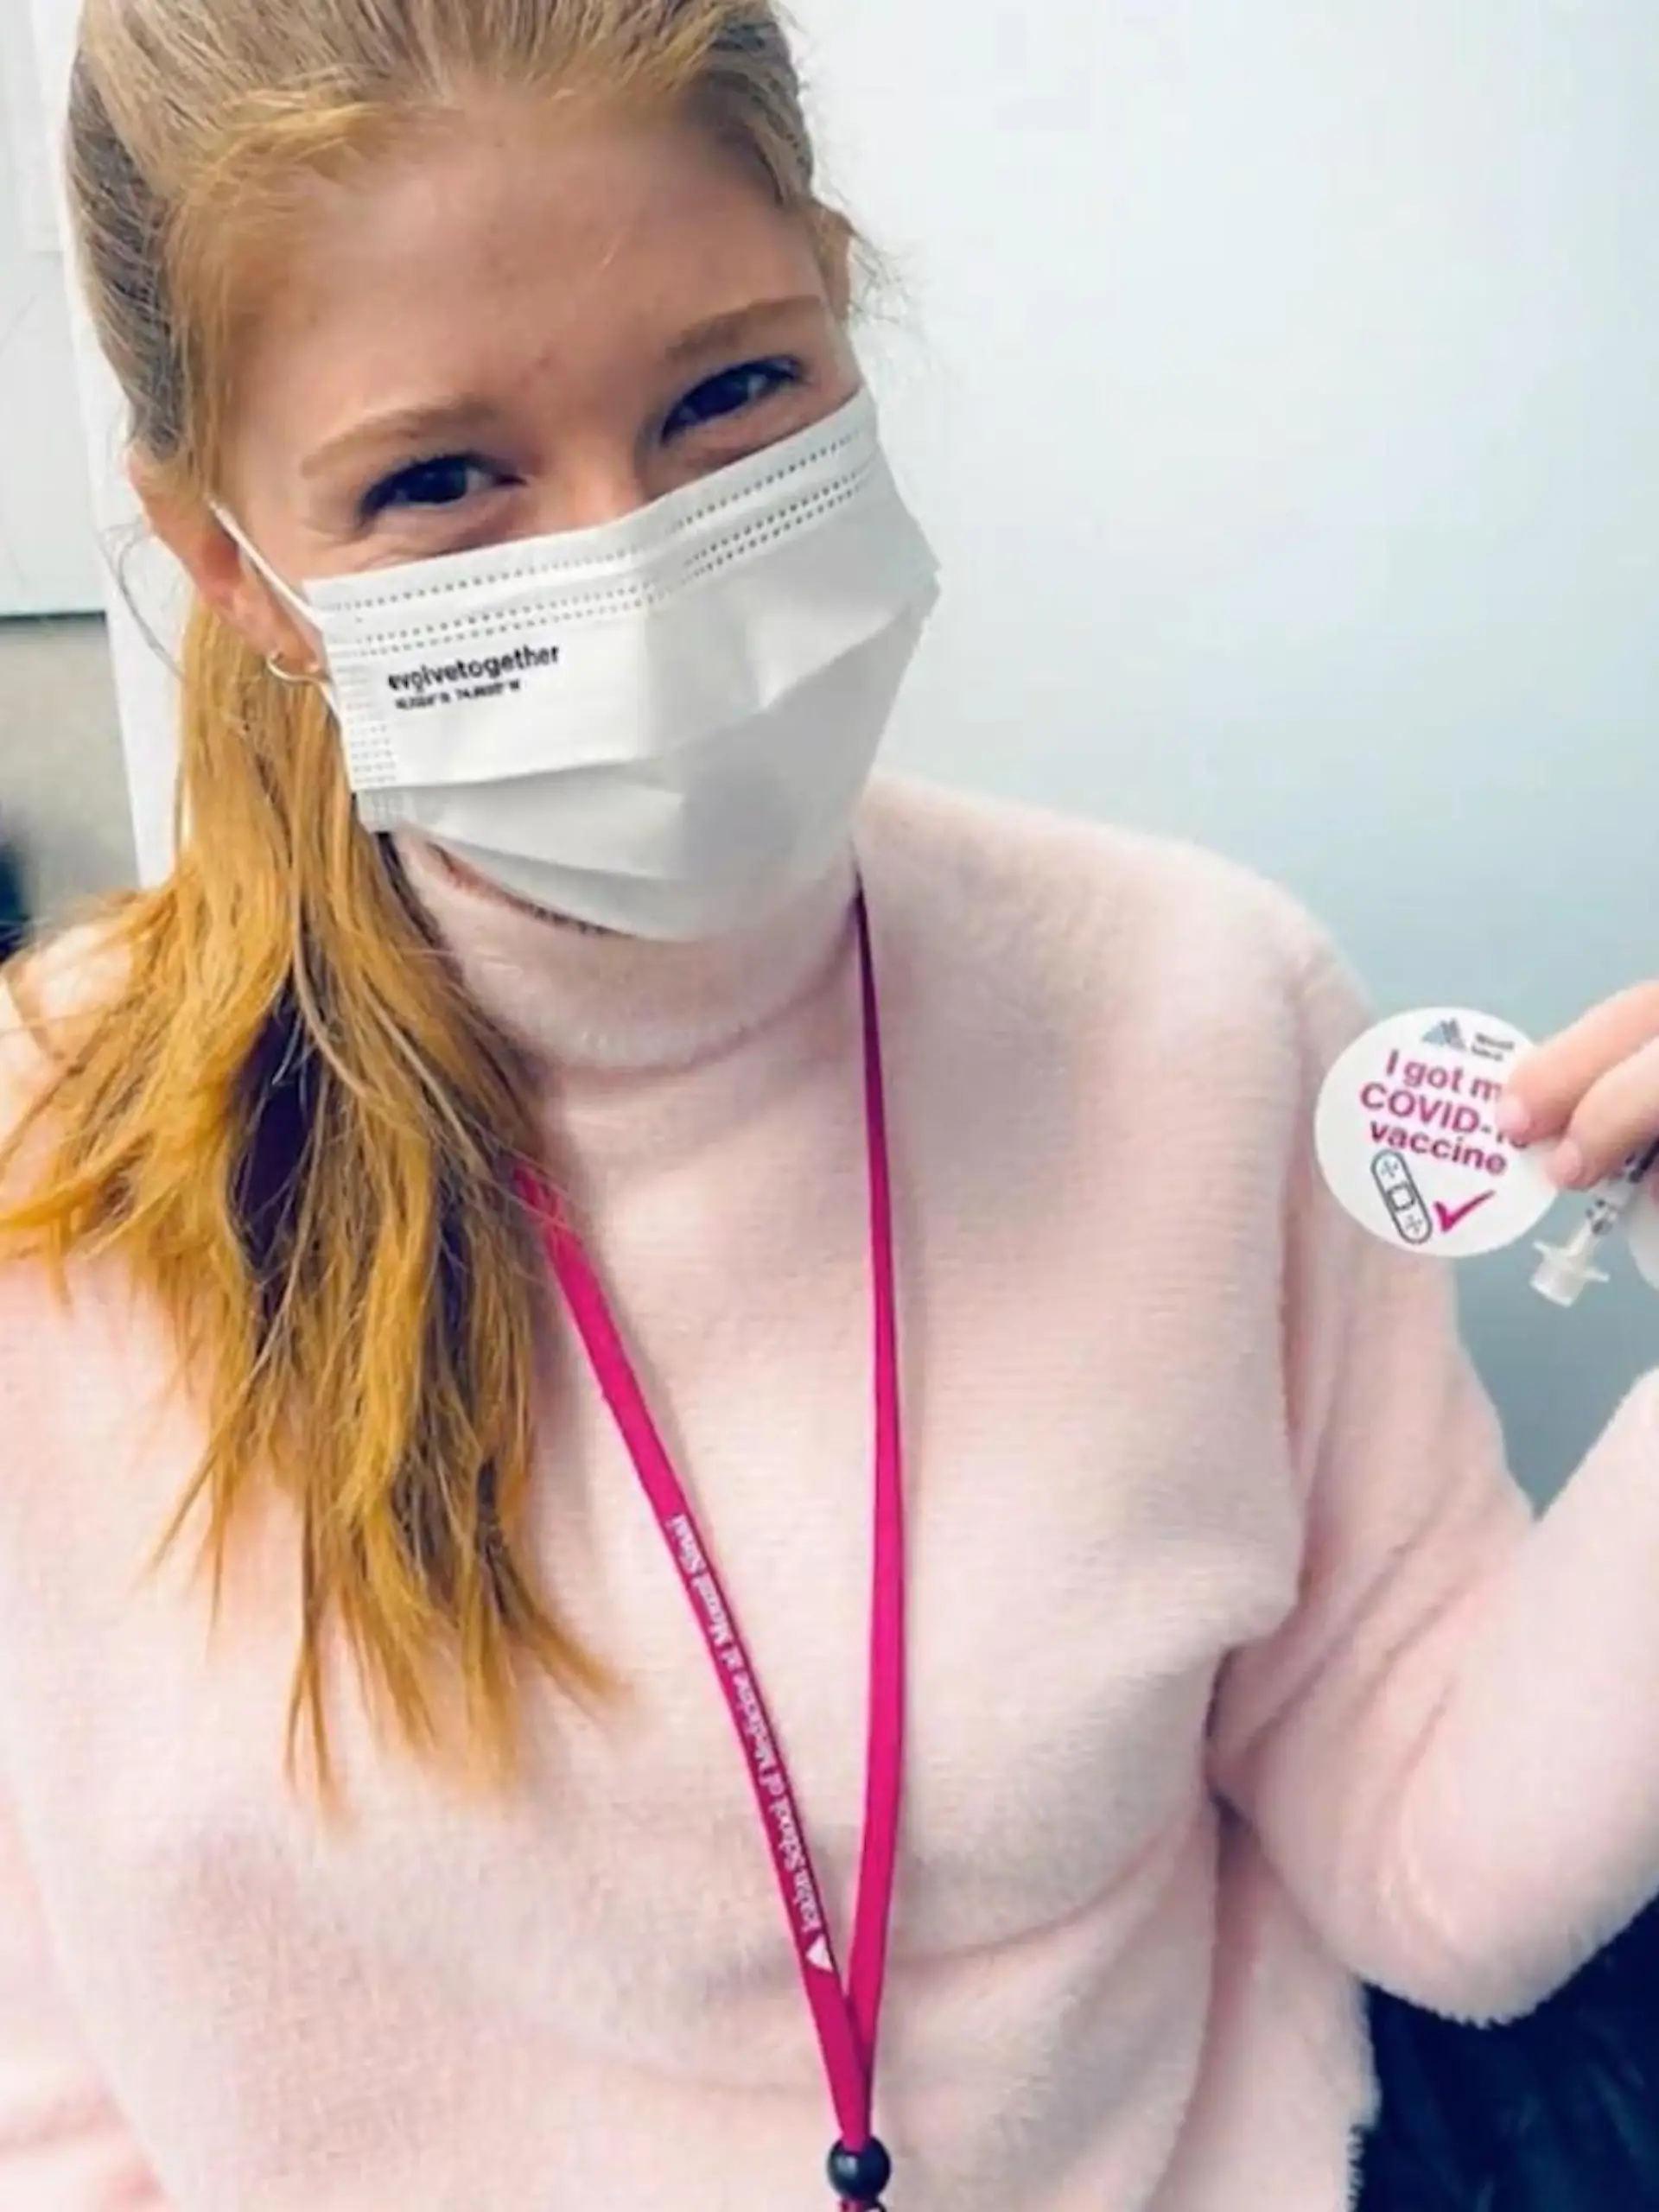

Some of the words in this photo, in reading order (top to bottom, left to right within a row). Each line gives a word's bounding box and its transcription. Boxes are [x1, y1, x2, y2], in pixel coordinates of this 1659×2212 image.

[388, 645, 559, 692] evolvetogether
[1385, 1049, 1400, 1077] I
[1404, 1061, 1463, 1092] got
[1469, 1076, 1503, 1103] m
[1360, 1082, 1530, 1150] COVID-
[1370, 1121, 1508, 1176] vaccine
